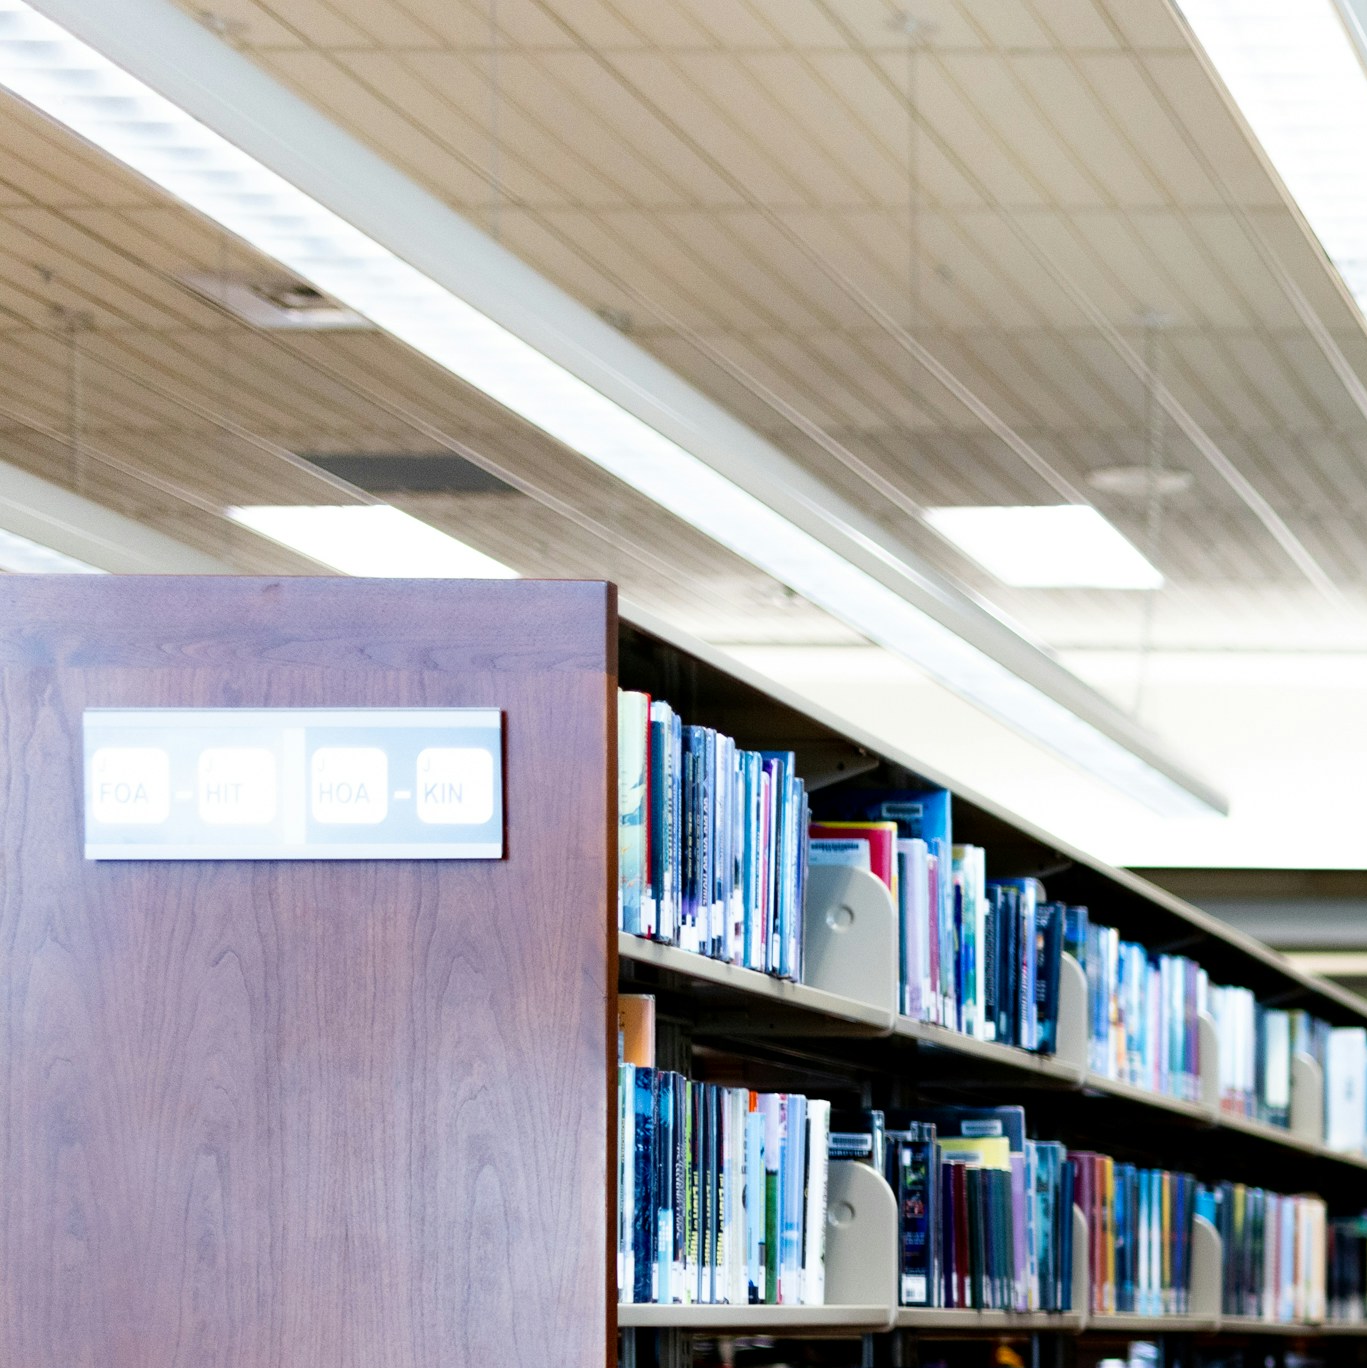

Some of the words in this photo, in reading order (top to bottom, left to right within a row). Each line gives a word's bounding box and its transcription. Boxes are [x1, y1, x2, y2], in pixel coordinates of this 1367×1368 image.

[99, 783, 149, 803] FOA
[207, 783, 242, 803] HIT
[319, 783, 370, 803] HOA
[424, 783, 463, 803] KIN
